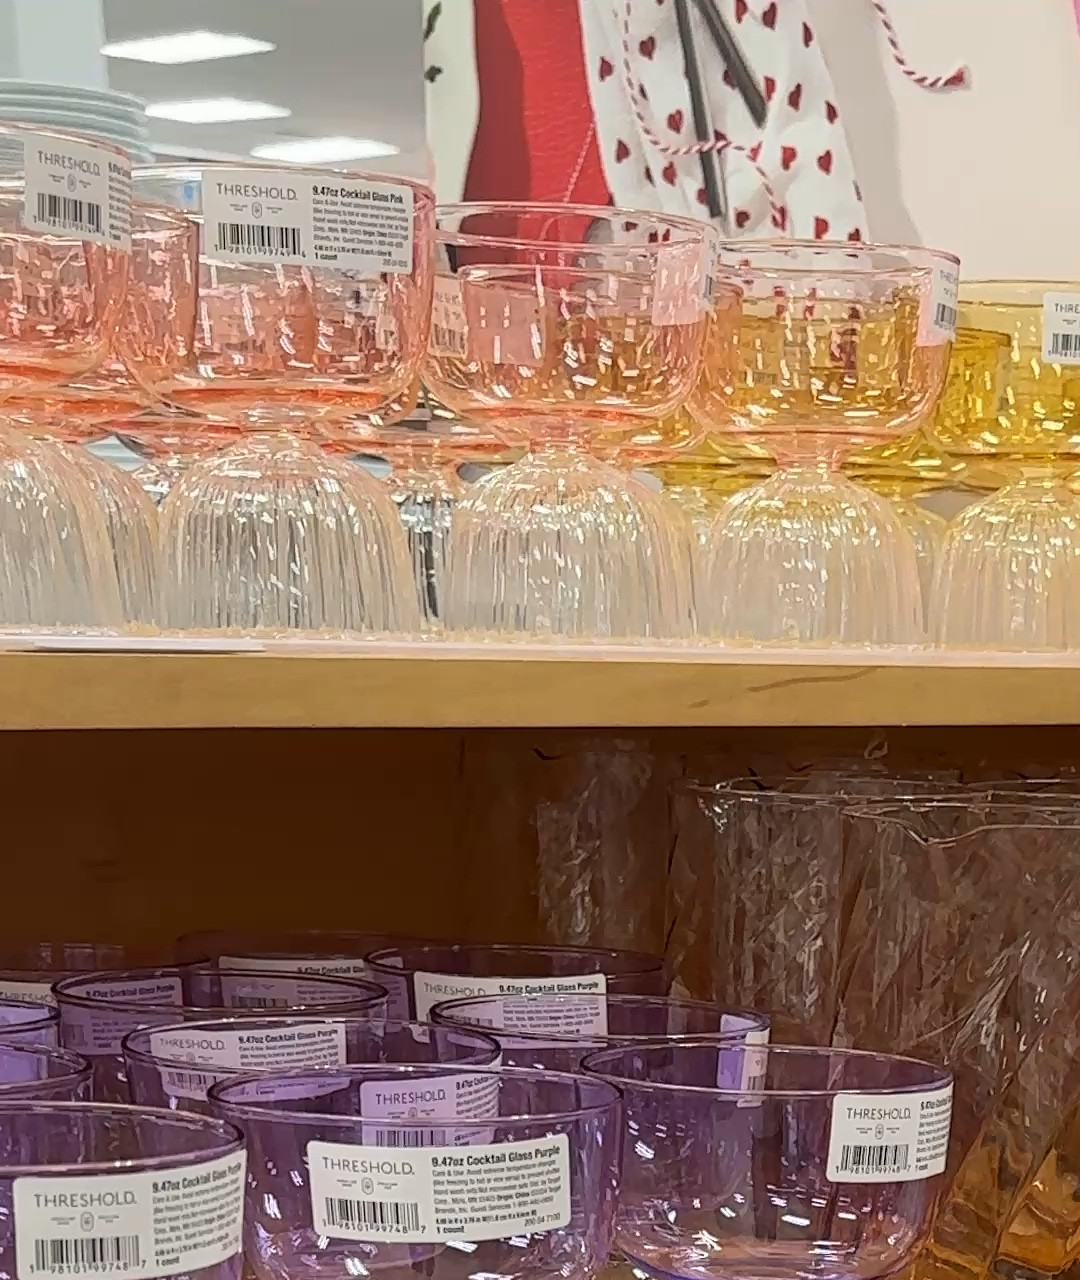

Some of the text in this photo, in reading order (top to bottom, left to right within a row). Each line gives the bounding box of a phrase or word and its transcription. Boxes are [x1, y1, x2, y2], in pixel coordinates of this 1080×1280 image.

[431, 1145, 561, 1168] 9.47oz Cocktail Glass Purple
